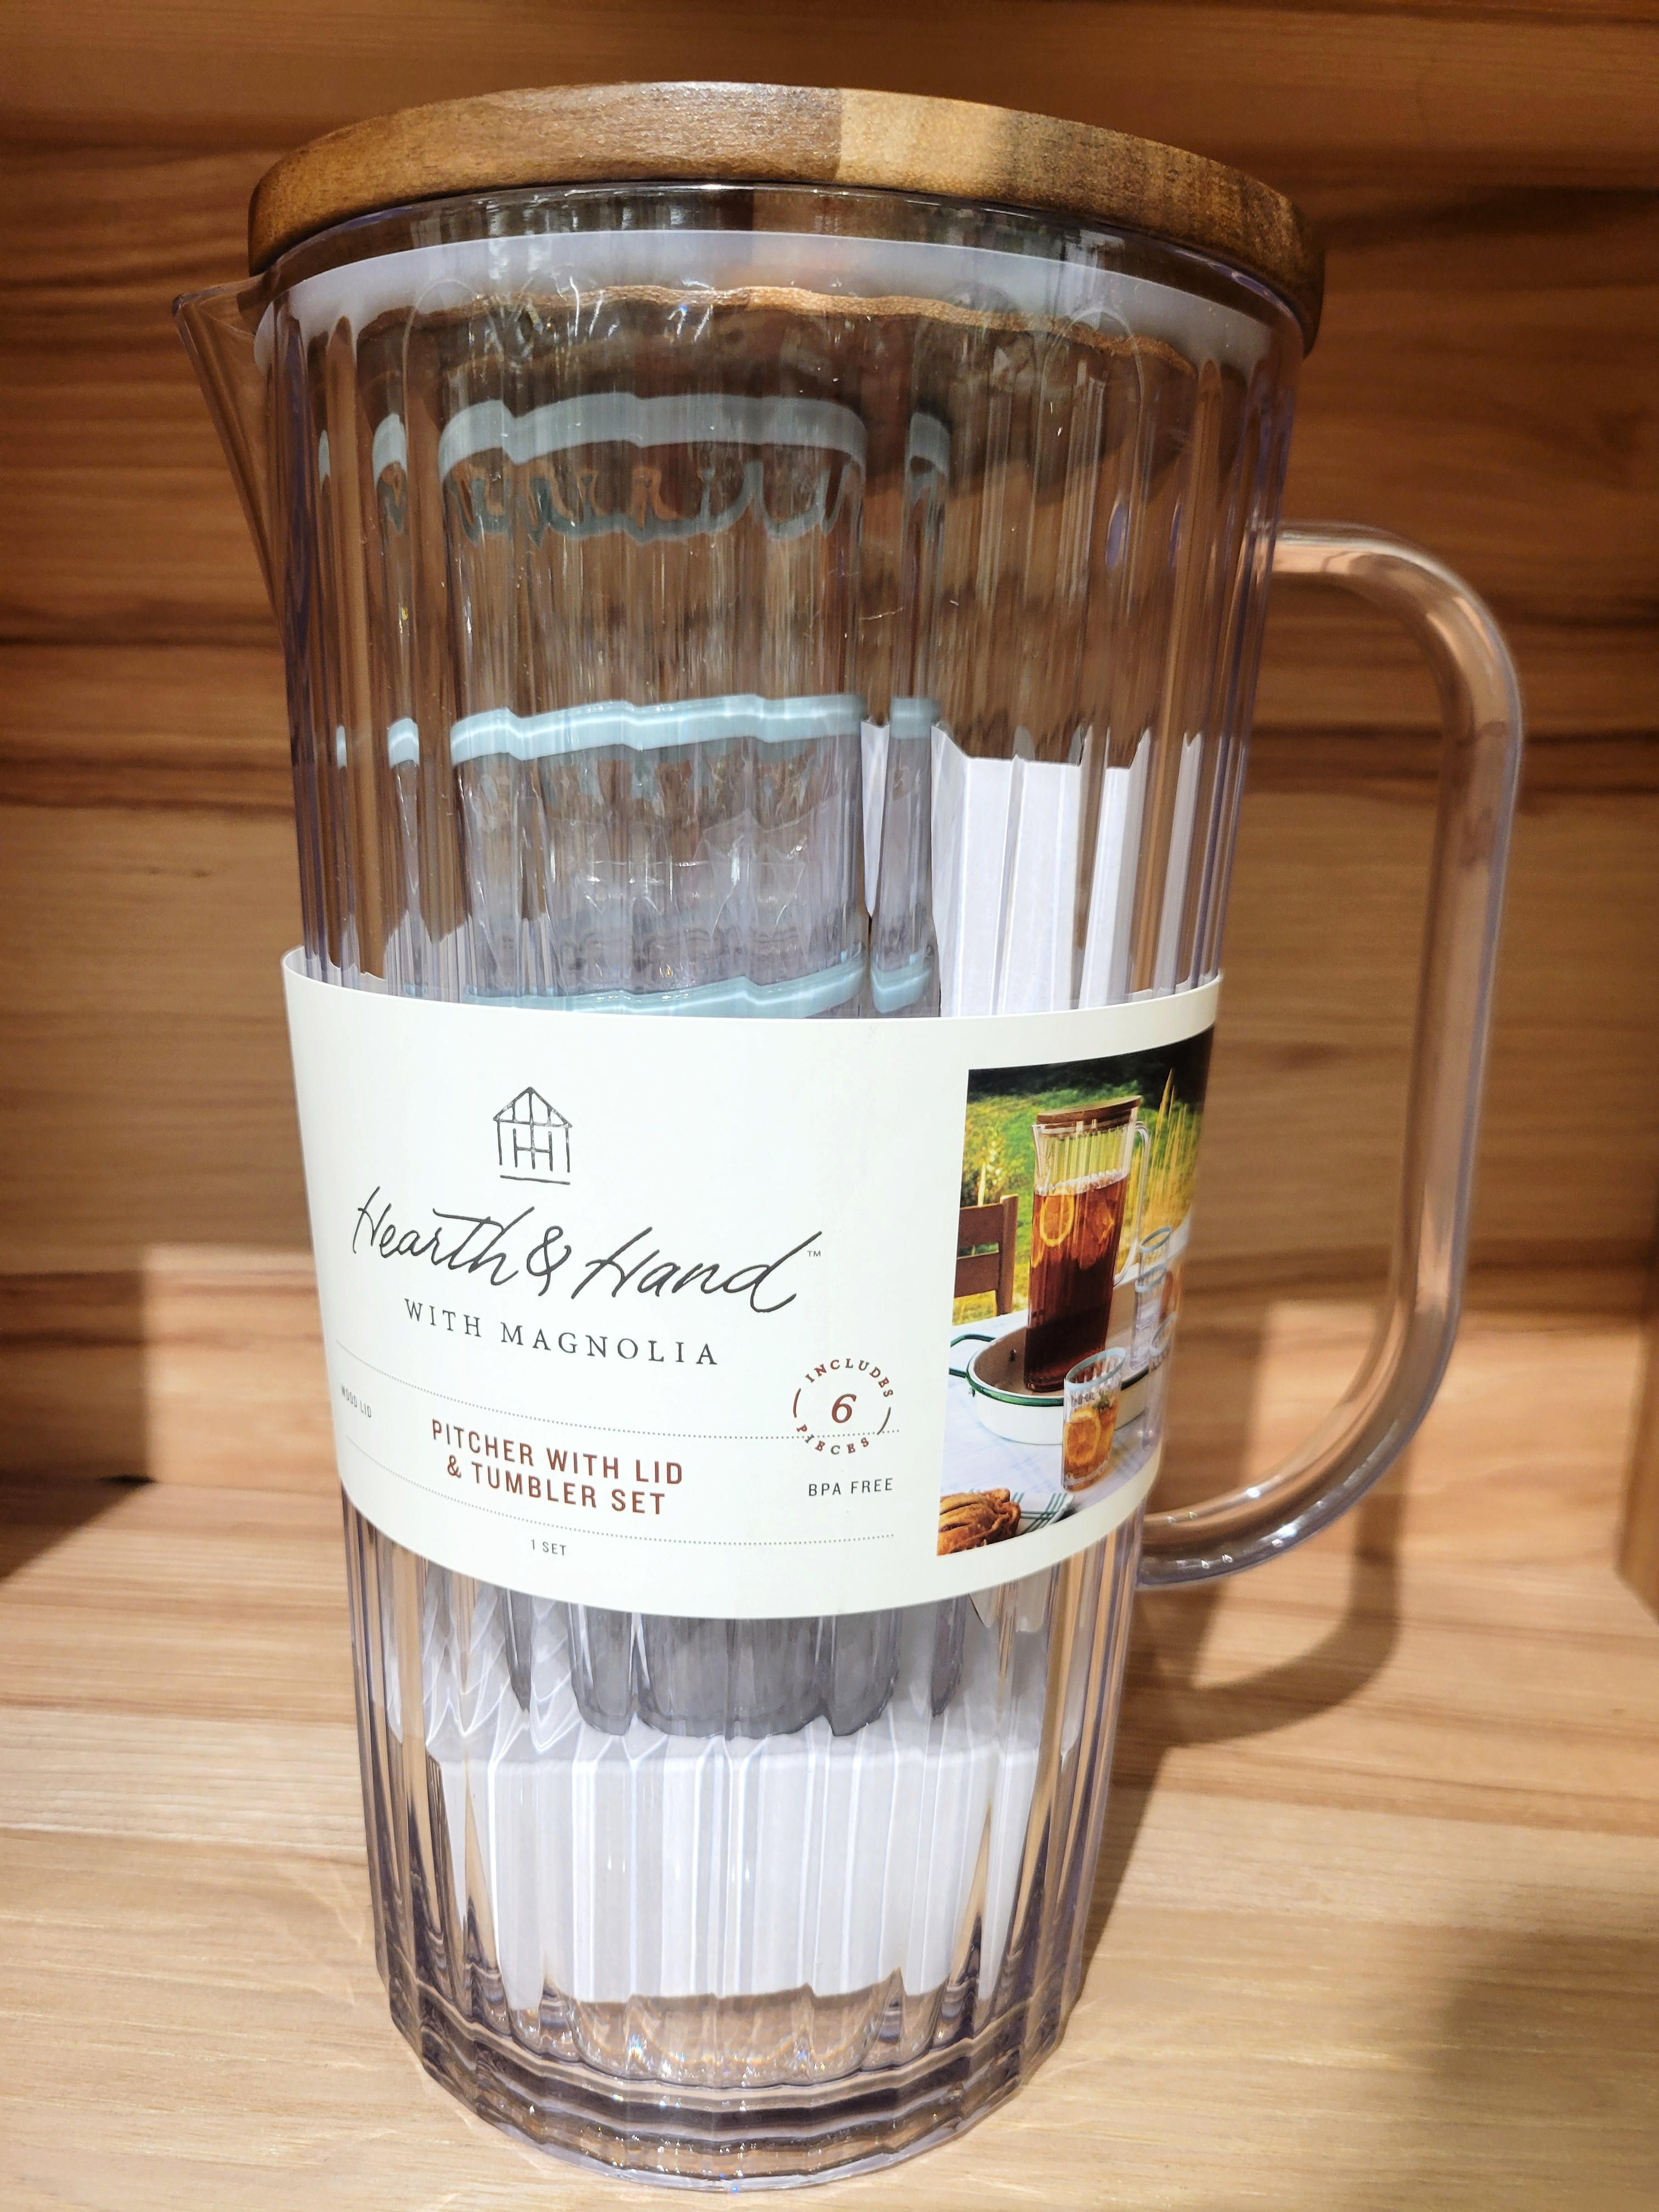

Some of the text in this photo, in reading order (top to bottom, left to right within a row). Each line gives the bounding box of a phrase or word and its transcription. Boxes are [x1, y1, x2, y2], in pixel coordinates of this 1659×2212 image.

[526, 1225, 572, 1296] &
[571, 1227, 822, 1313] Hand
[403, 1297, 718, 1366] WITH MAGNOLIA
[805, 1357, 894, 1398] INCLUDES
[341, 1383, 372, 1418] WOOD LID
[831, 1392, 857, 1424] 6
[431, 1418, 683, 1485] PITCHER WITH LID
[796, 1424, 870, 1455] PIECES
[447, 1454, 665, 1515] & TUMBLER SET
[808, 1477, 894, 1497] BPA FREE
[531, 1538, 567, 1556] 1 SET
